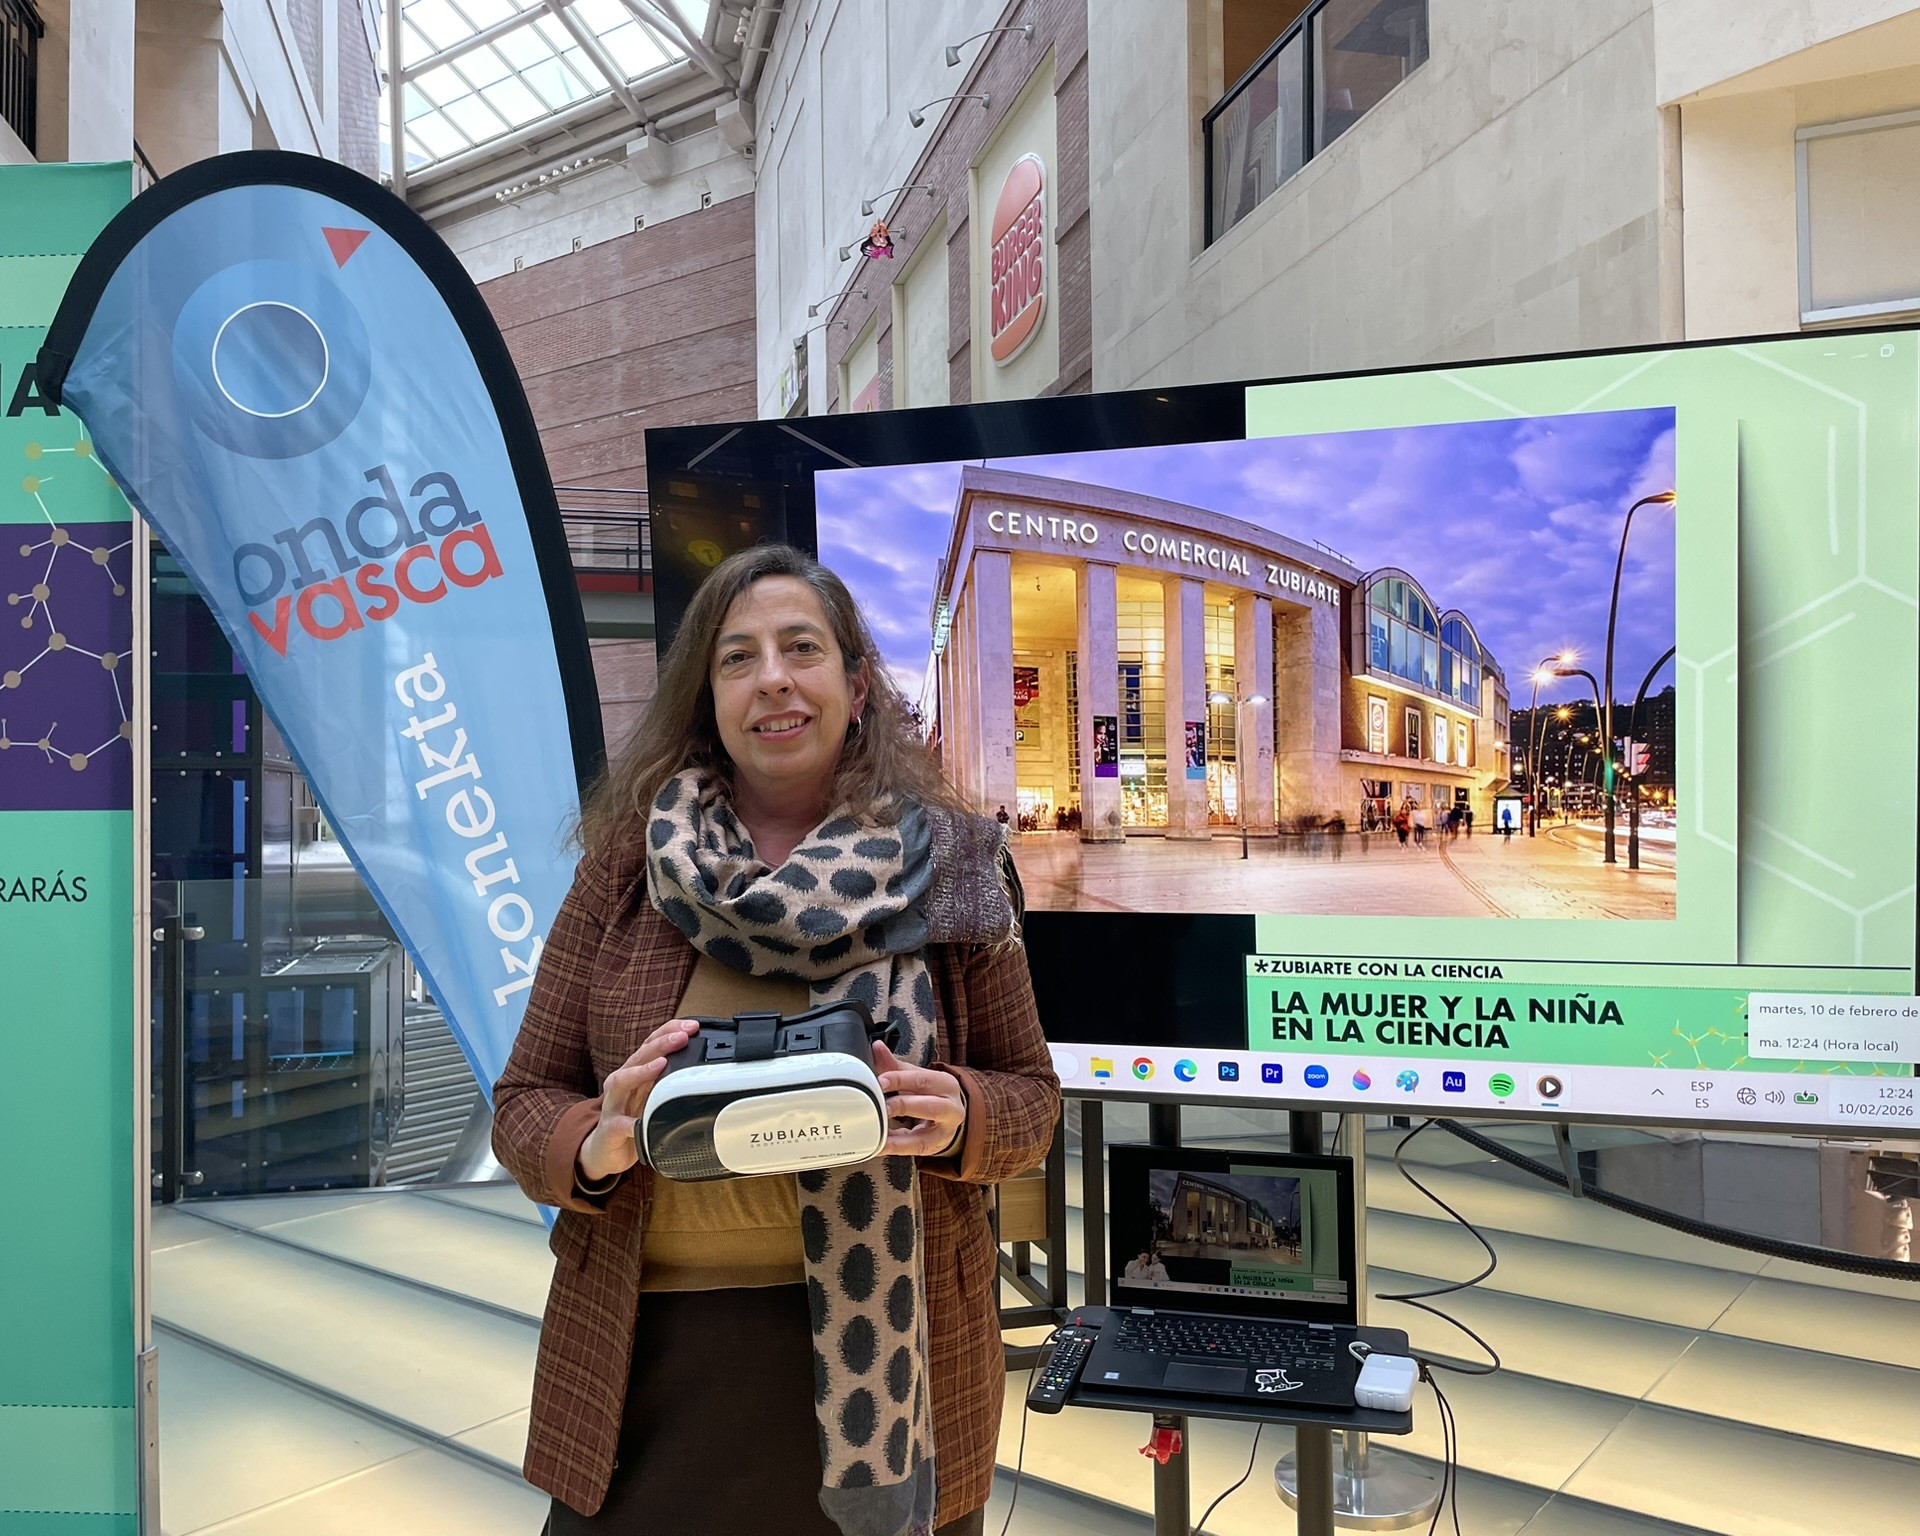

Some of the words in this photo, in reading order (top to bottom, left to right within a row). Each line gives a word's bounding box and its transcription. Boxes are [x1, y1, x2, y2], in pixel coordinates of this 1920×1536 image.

[992, 199, 1042, 286] BURGER
[991, 240, 1042, 338] KING
[0, 362, 61, 417] A
[233, 464, 482, 607] onda
[988, 511, 1098, 544] CENTRO
[1123, 531, 1251, 576] COMERCIAL
[1267, 564, 1340, 606] ZUBIARTE
[248, 522, 504, 658] vasca
[395, 652, 542, 1007] konekta
[1358, 963, 1398, 977] CON
[1404, 964, 1426, 978] LA
[1431, 964, 1504, 980] CIENCIA
[1271, 990, 1309, 1015] LA
[1320, 992, 1429, 1019] MUJER
[1440, 995, 1463, 1019] Y
[1475, 997, 1516, 1022] LA
[1529, 993, 1625, 1025] NIÑA
[1759, 1004, 1806, 1016] martes,
[1811, 1005, 1825, 1016] 10
[1828, 1005, 1845, 1016] de
[1850, 1005, 1898, 1018] febrero
[1901, 1006, 1919, 1018] de
[1272, 1017, 1313, 1041] EN
[1326, 1018, 1365, 1043] LA
[1375, 1020, 1510, 1049] CIENCIA
[1759, 1039, 1782, 1049] ma.
[1786, 1038, 1819, 1049] 12:24
[1823, 1039, 1859, 1051] (Hora
[1863, 1040, 1899, 1053] local)
[1221, 1065, 1236, 1077] Ps
[1265, 1067, 1279, 1079] Pr
[1444, 1076, 1463, 1087] Au
[1691, 1081, 1713, 1092] ESP
[1878, 1087, 1914, 1099] 12:24
[1695, 1098, 1710, 1109] ES
[1838, 1103, 1914, 1116] 10/02/2026
[750, 1124, 842, 1143] ZUBIARTE
